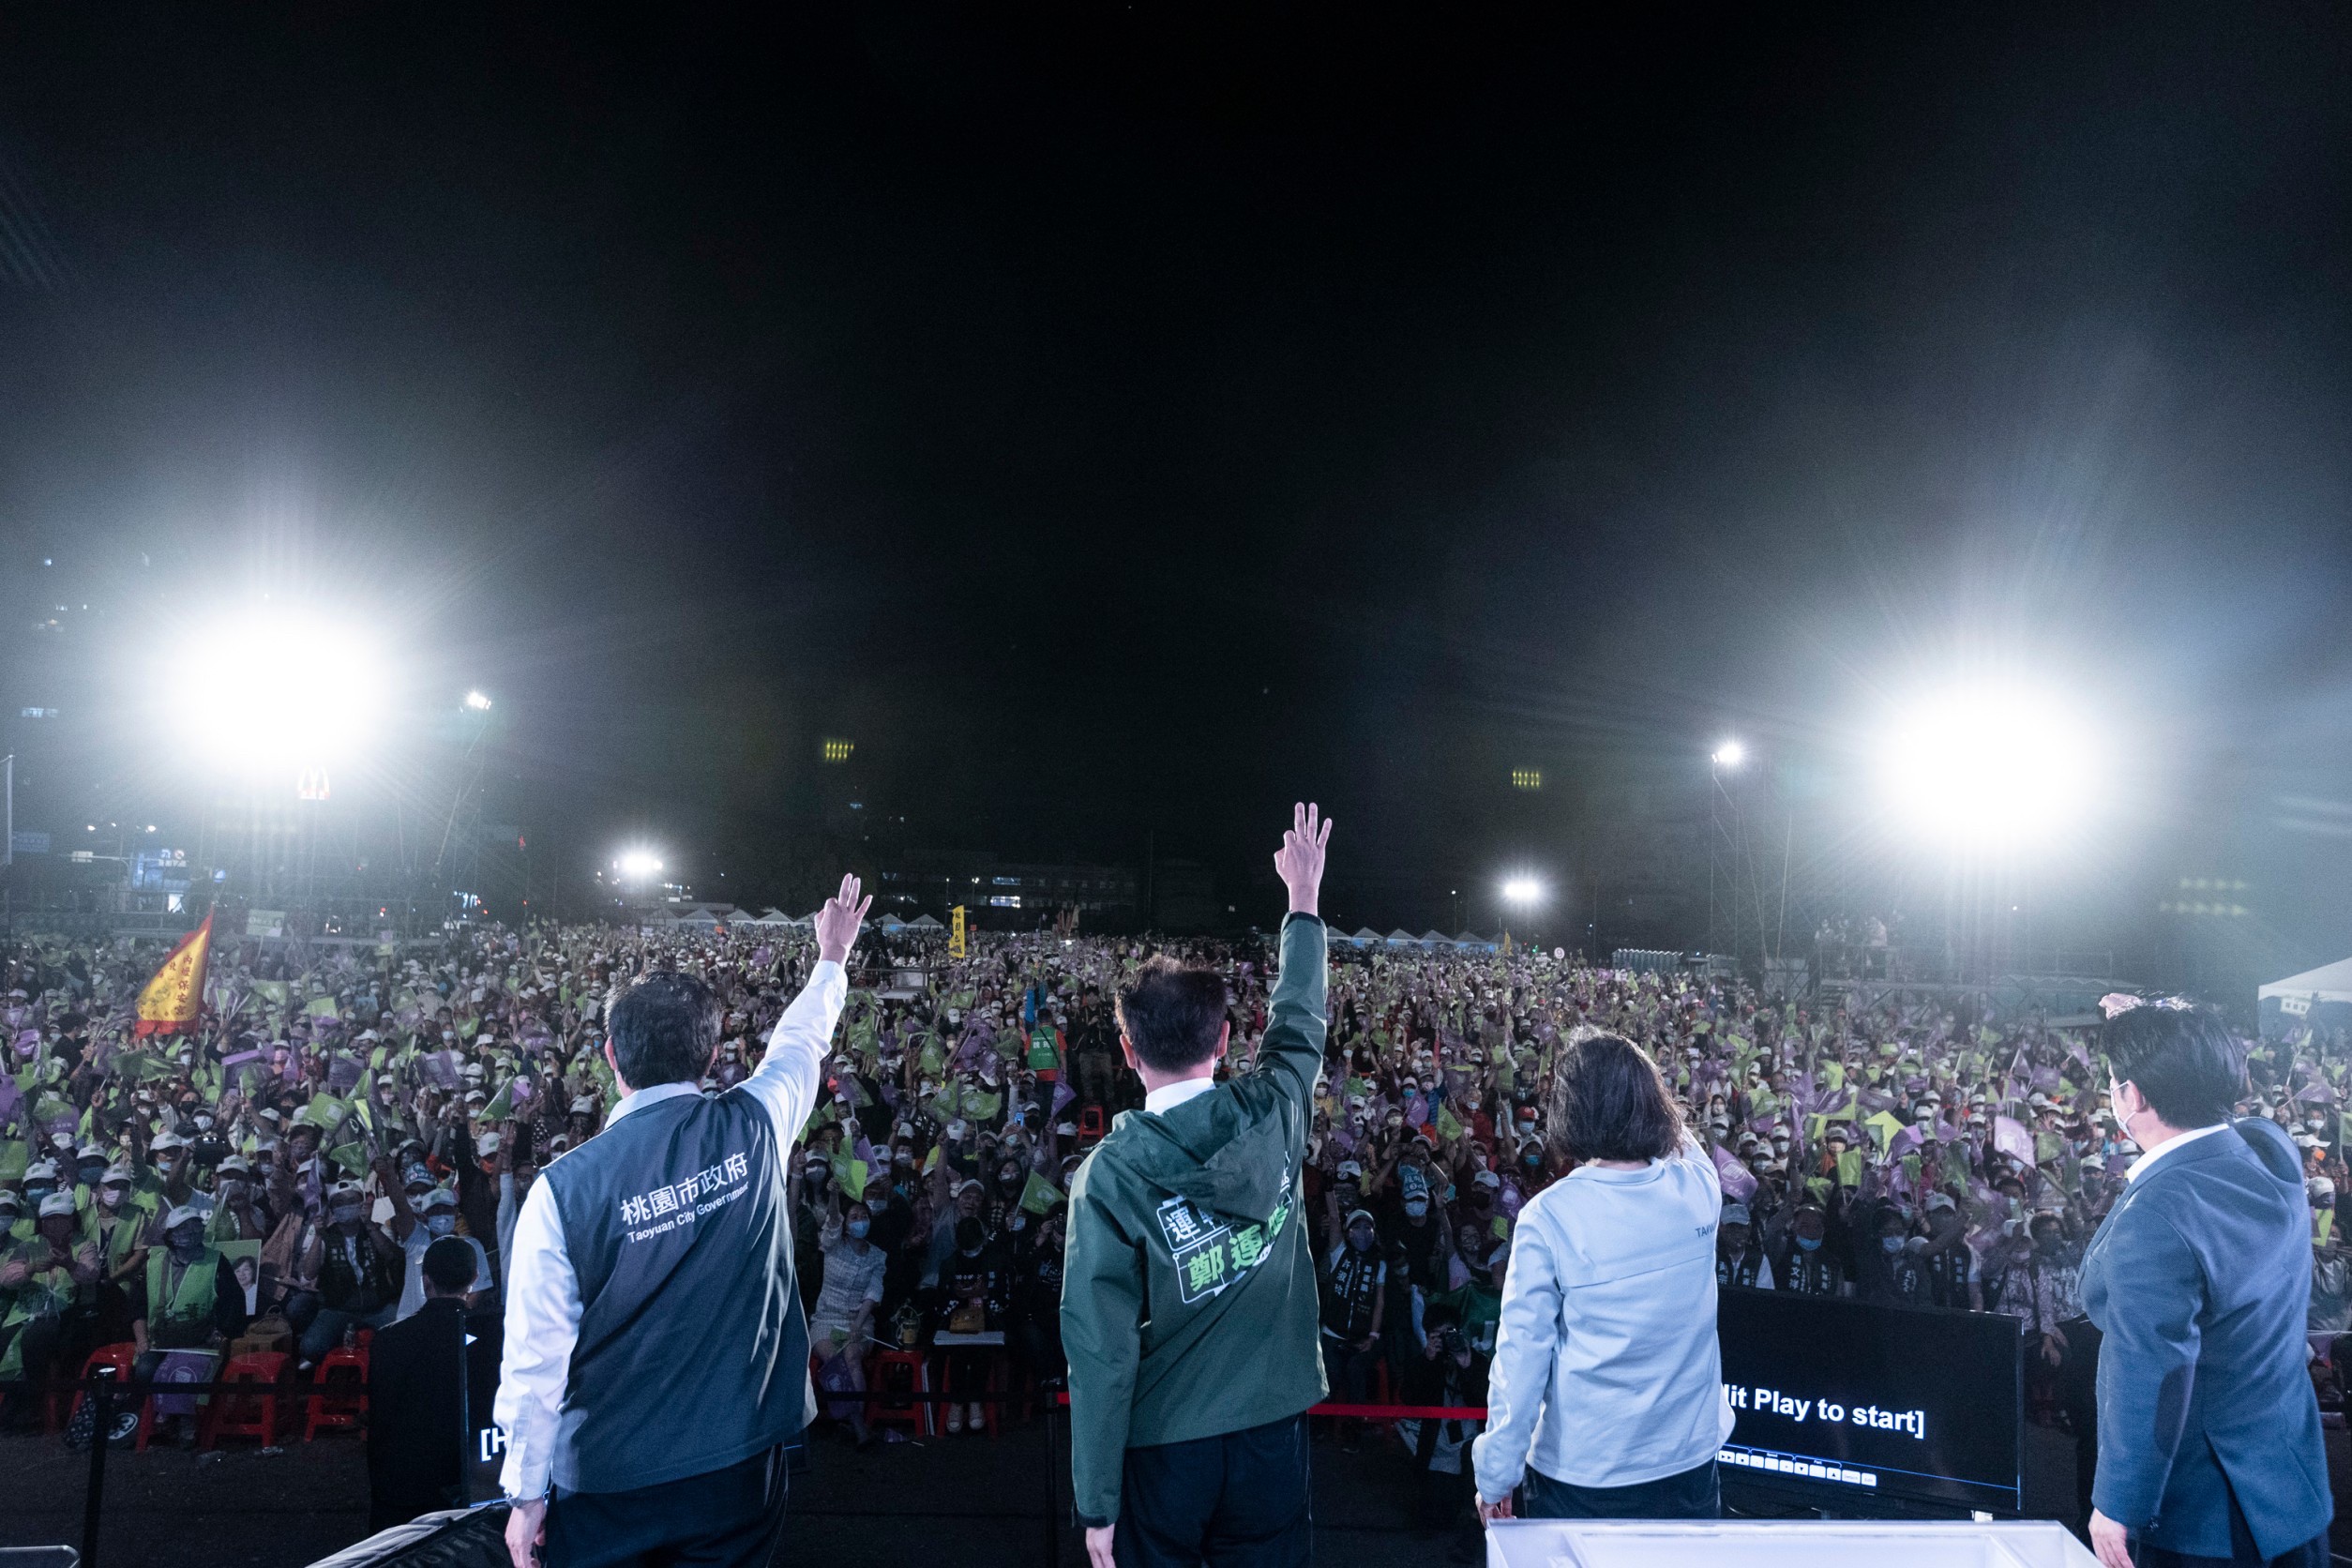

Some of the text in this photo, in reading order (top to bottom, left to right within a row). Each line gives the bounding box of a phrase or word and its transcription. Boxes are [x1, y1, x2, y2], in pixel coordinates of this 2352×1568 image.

[620, 1152, 747, 1226] 桃園市政府
[627, 1181, 749, 1244] Taoyuan City Government
[1754, 1388, 1811, 1422] Play
[1817, 1398, 1845, 1422] to
[1852, 1405, 1925, 1440] start]
